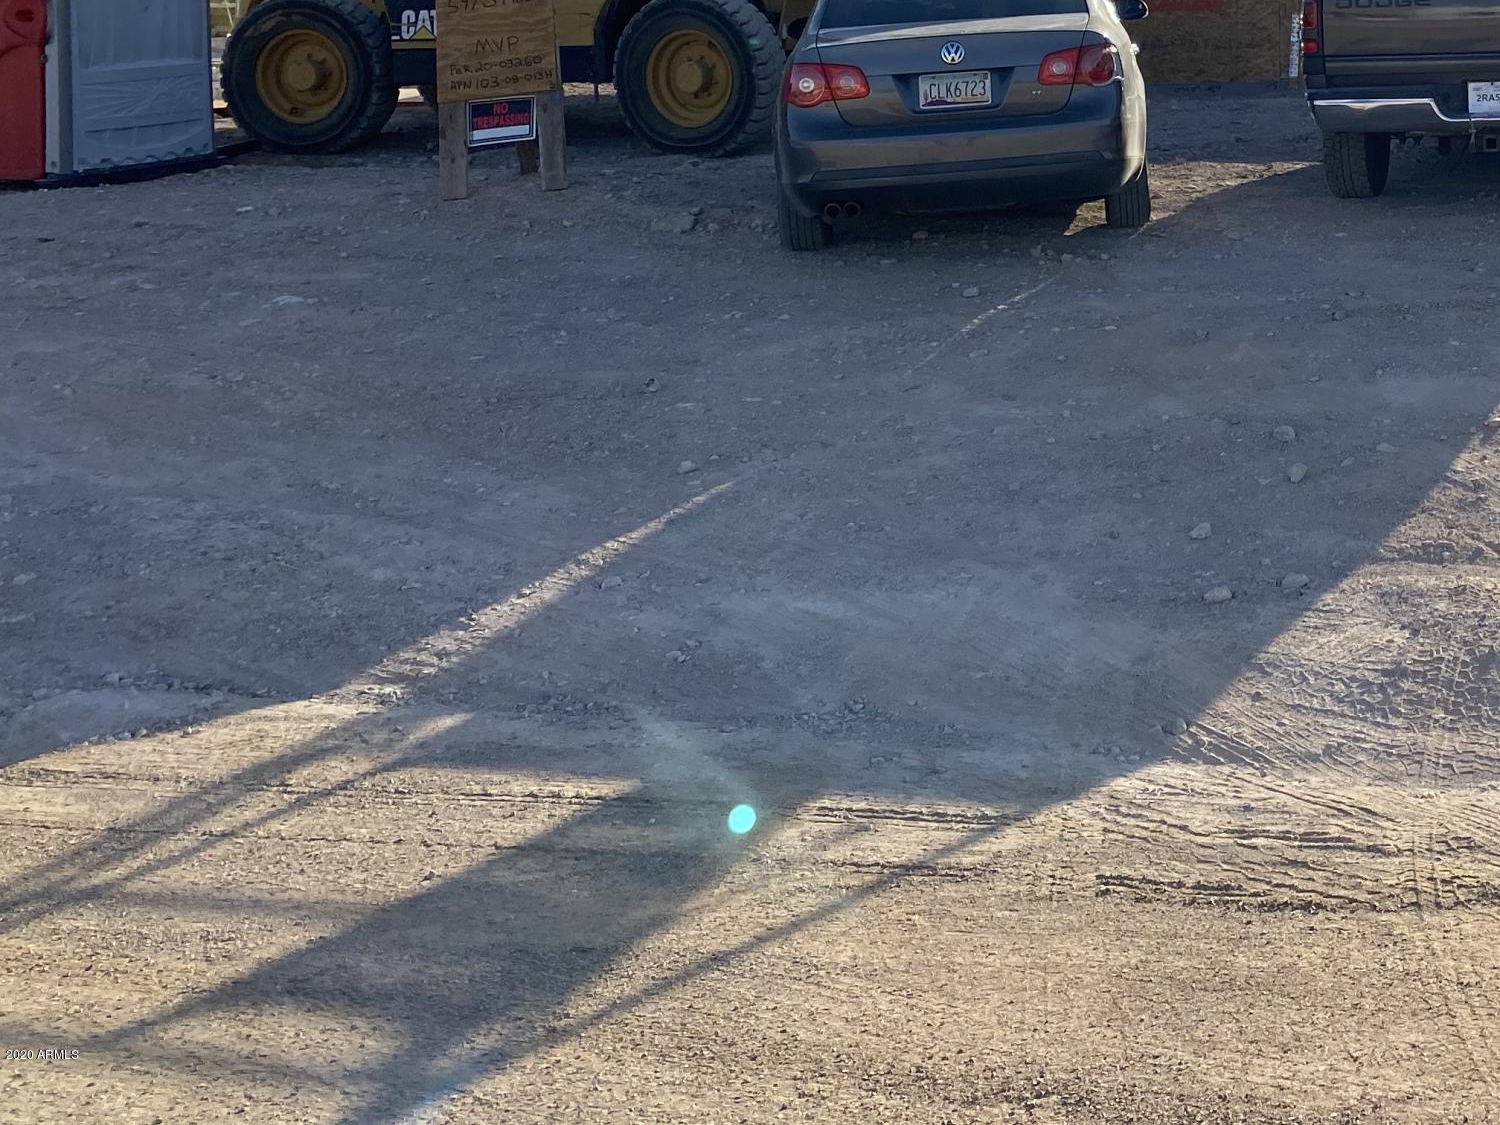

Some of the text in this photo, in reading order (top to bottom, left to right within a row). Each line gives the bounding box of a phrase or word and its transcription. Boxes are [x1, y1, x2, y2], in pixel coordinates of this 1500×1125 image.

[474, 36, 519, 55] MVP
[929, 80, 987, 100] CLK6723
[493, 102, 509, 114] NO
[473, 113, 530, 129] TRESPASSING
